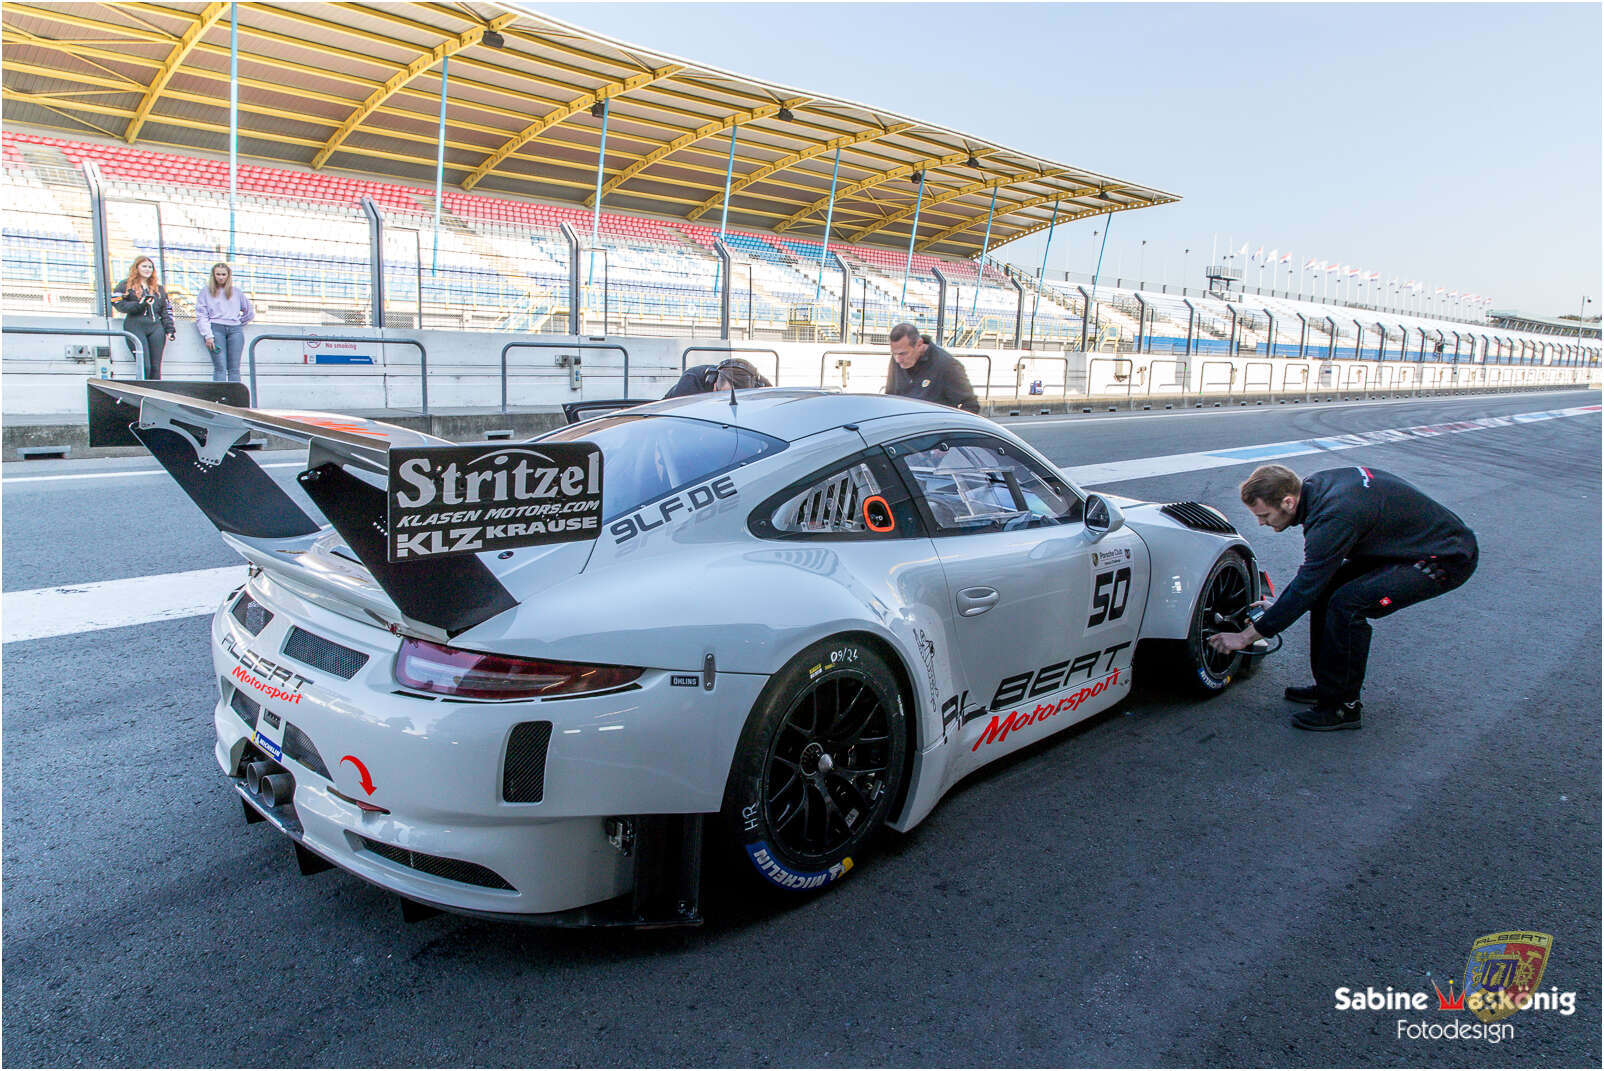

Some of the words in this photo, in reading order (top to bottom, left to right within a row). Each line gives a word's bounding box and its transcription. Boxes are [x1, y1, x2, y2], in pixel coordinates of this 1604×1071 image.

[334, 342, 357, 351] smoking
[396, 451, 600, 508] Stritzel
[396, 509, 482, 529] KLASEN
[484, 500, 600, 521] MOTORS.COM
[610, 475, 738, 545] 9LF.DE
[396, 526, 483, 558] KLZ
[486, 516, 598, 539] KRAUSE
[1087, 566, 1132, 629] 50
[221, 632, 315, 693] ALBERT
[830, 648, 859, 663] 09/24
[231, 664, 303, 705] Motorsport
[941, 640, 1132, 744] ALBERT
[971, 667, 1123, 752] Motorsport
[753, 848, 828, 889] MICHELIN
